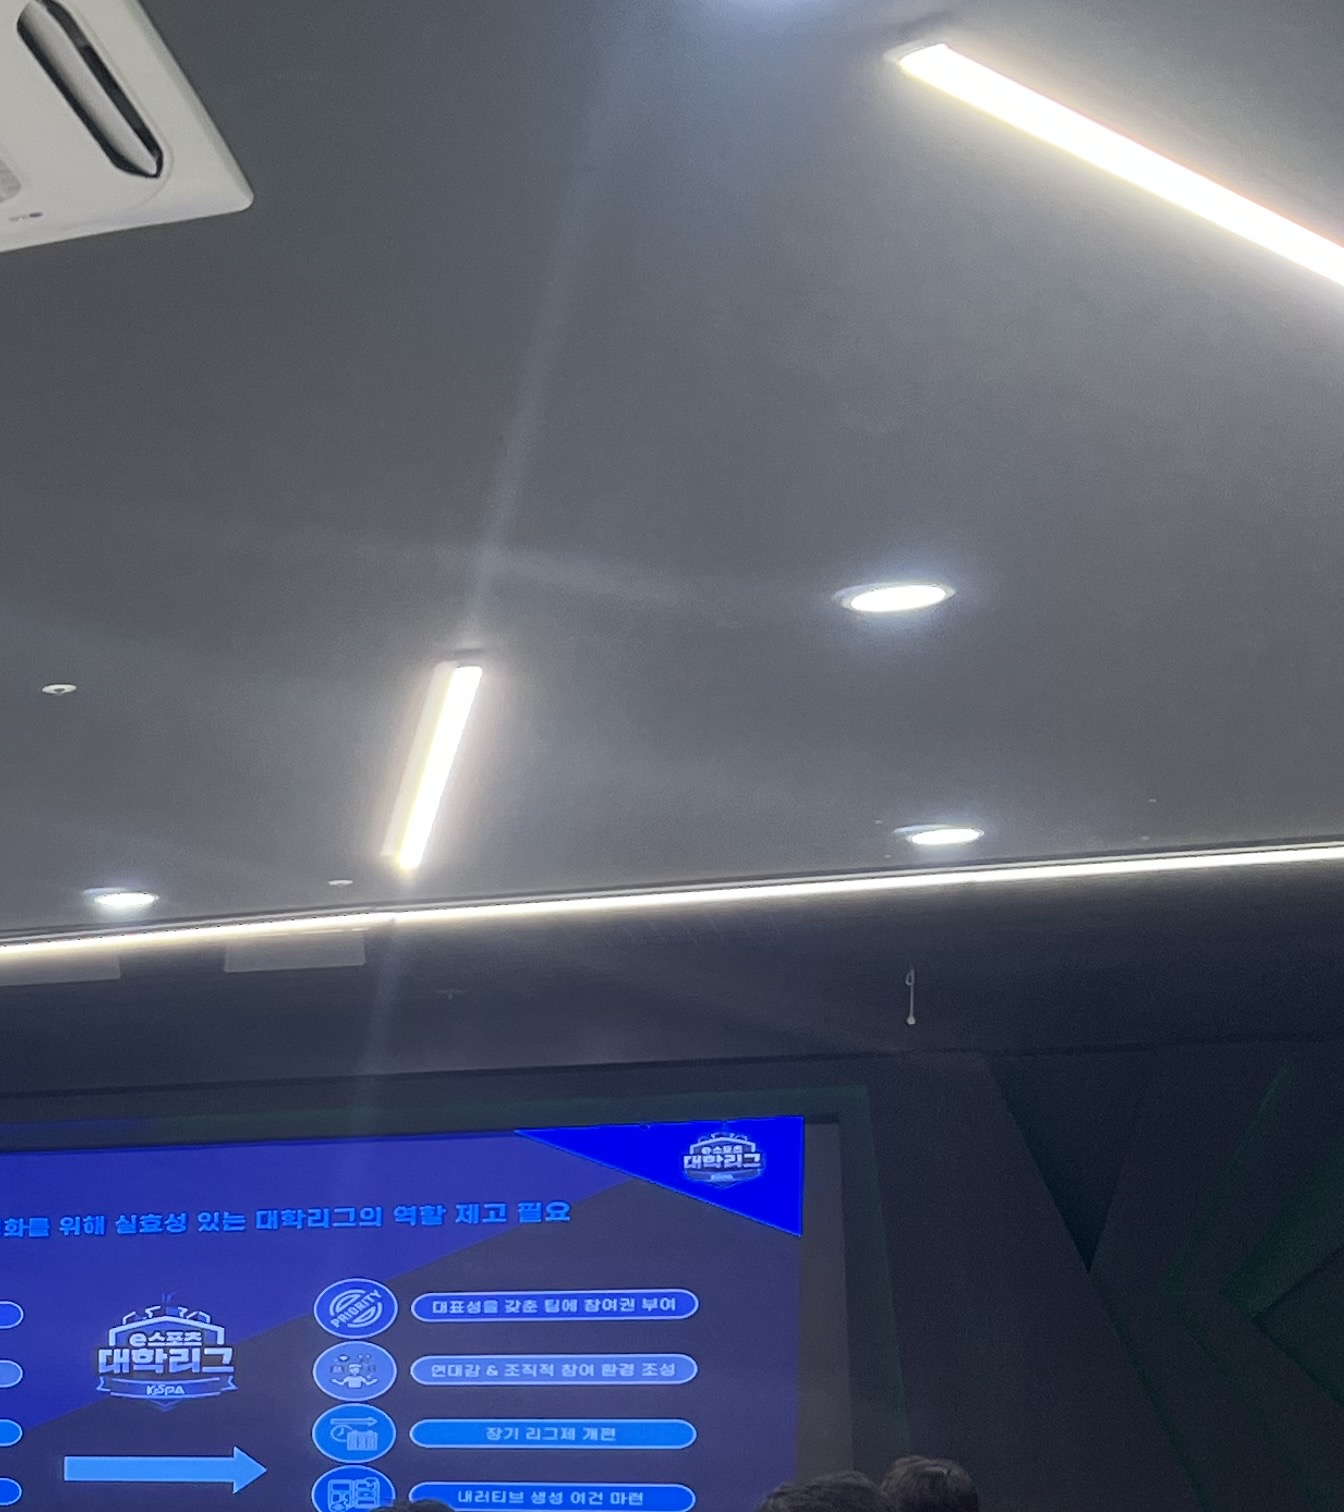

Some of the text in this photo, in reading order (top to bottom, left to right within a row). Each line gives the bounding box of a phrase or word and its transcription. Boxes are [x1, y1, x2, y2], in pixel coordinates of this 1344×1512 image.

[683, 1153, 761, 1169] 대학리그
[59, 1214, 106, 1236] 위해
[115, 1212, 187, 1235] 실효성
[197, 1210, 246, 1233] 있는
[255, 1206, 383, 1231] 대학리그의
[394, 1204, 446, 1227] 역할
[455, 1202, 507, 1225] 제고
[517, 1201, 571, 1223] 필요
[330, 1289, 382, 1329] PRIORITY
[432, 1298, 676, 1315] 대표성을 갖춘 팀에 참여권 부여
[129, 1331, 202, 1347] e스포츠
[98, 1347, 235, 1374] 대학리그
[431, 1363, 676, 1378] 연대감 & 조직적 참여 환경 조성
[486, 1427, 617, 1442] 장기 리그제 개편
[457, 1491, 643, 1506] 내러티브 생성 여건 마련
